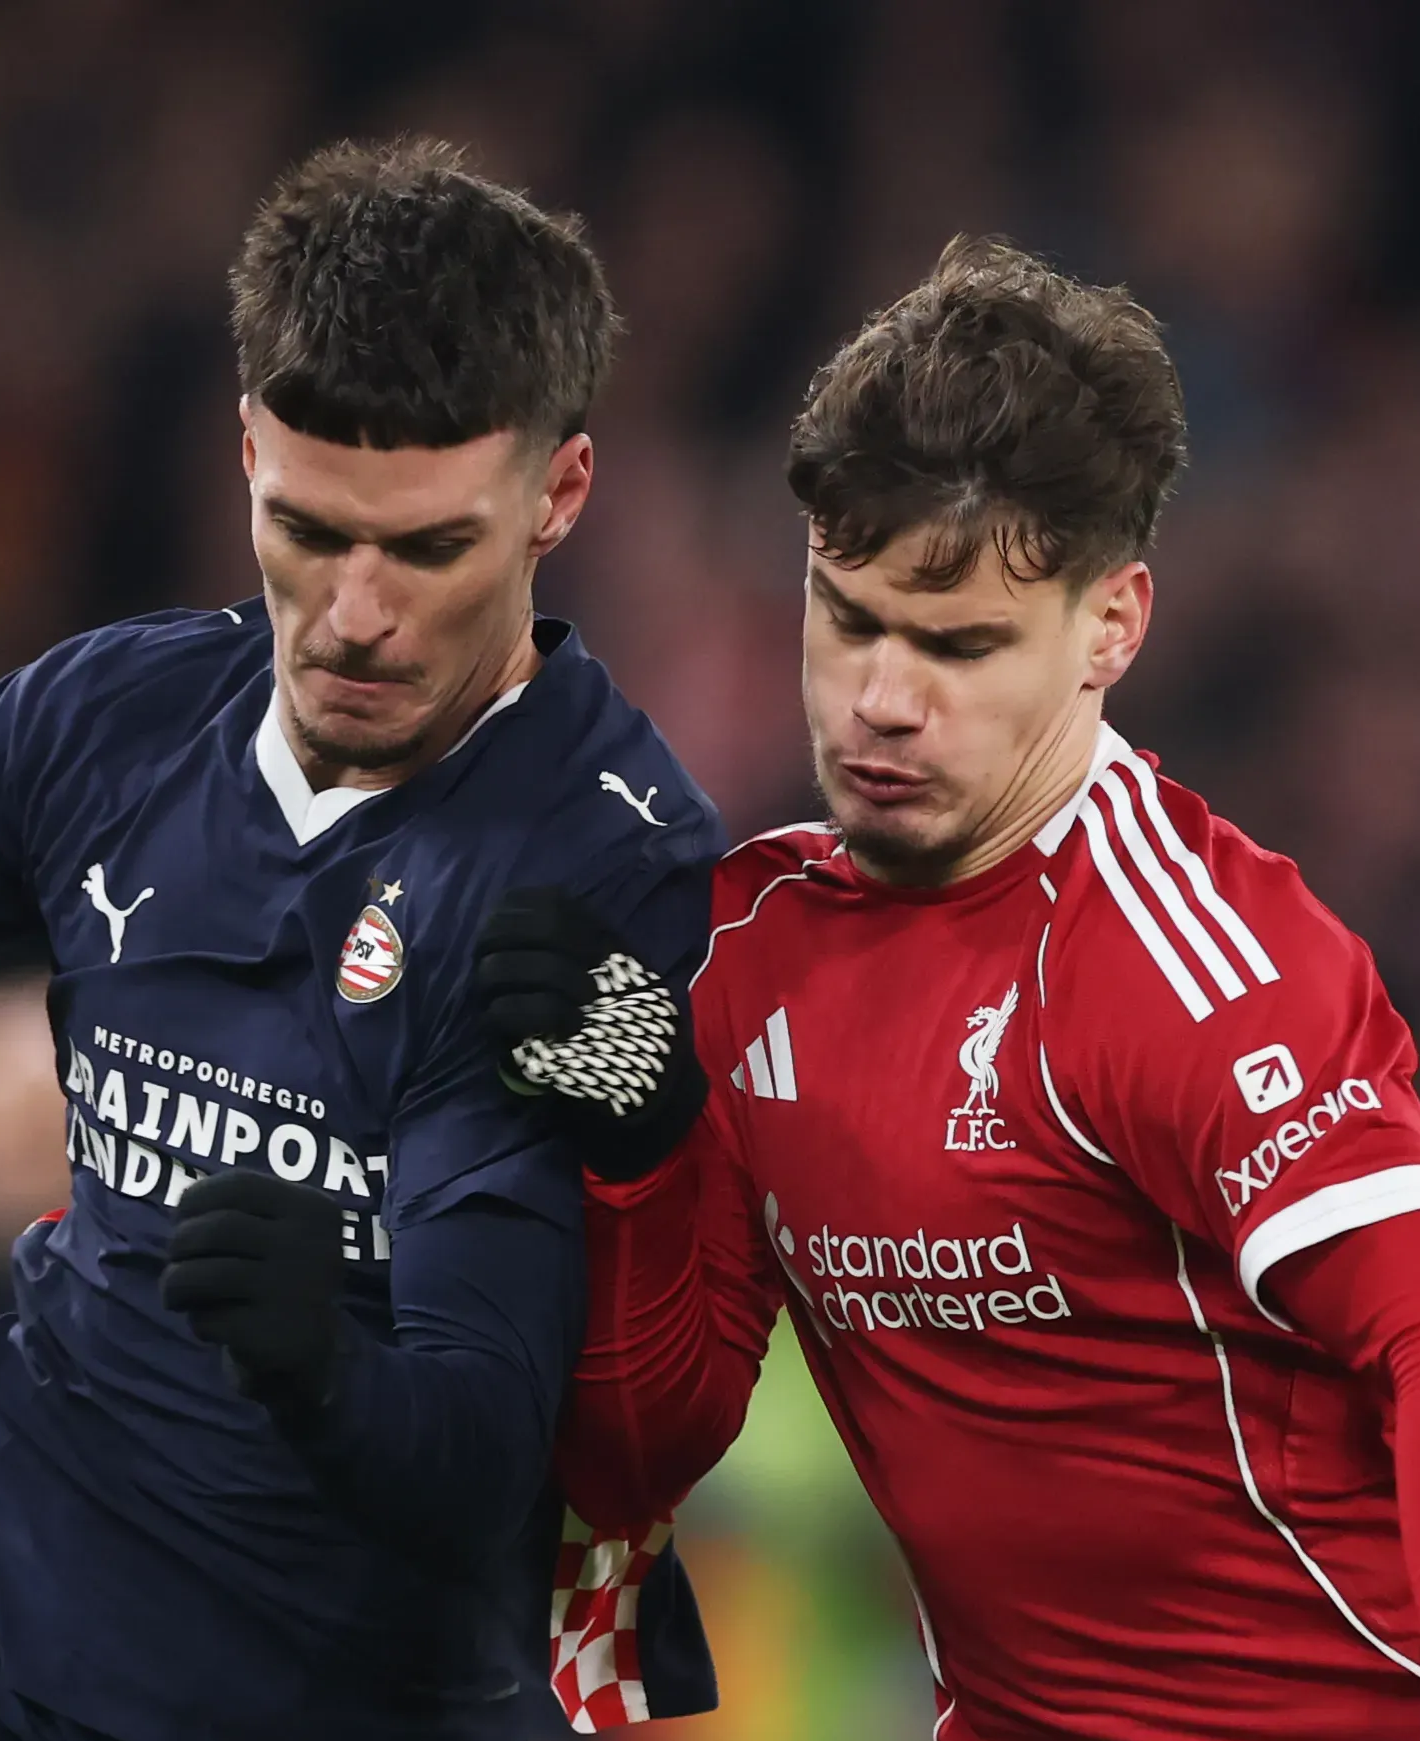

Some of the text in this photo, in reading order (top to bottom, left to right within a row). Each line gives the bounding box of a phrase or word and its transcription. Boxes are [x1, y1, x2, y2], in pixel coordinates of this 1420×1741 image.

[353, 938, 375, 961] PSV
[93, 1025, 326, 1120] METROPOOLREGIO
[944, 1118, 1017, 1152] L.F.C.
[808, 1222, 1032, 1280] standard
[822, 1273, 1072, 1331] chartered
